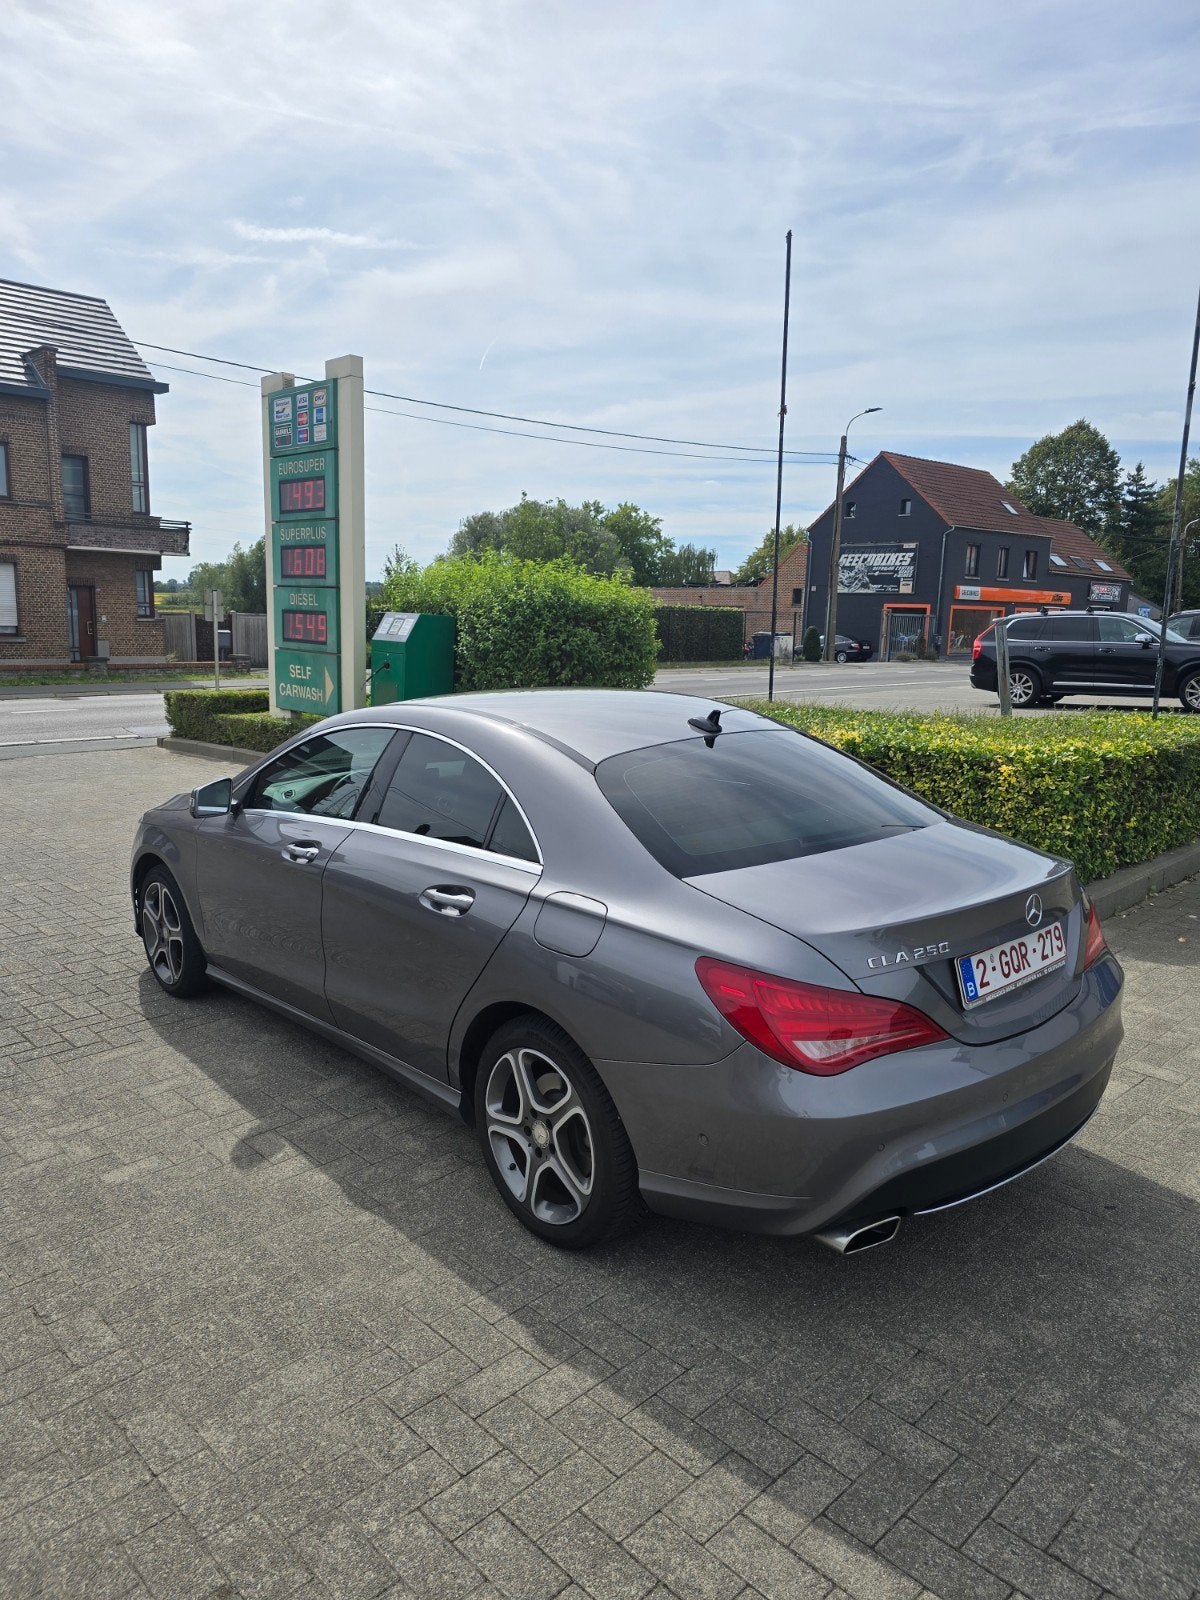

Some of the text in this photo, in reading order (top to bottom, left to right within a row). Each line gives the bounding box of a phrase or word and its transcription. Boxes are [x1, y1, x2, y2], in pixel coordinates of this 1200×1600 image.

[278, 458, 325, 475] EUROSUPER
[280, 526, 327, 541] SUPERPLUS
[289, 593, 319, 606] DIESEL
[289, 664, 312, 679] SELF
[279, 682, 323, 702] CARWASH
[867, 942, 950, 969] CLA 250
[966, 982, 976, 997] B
